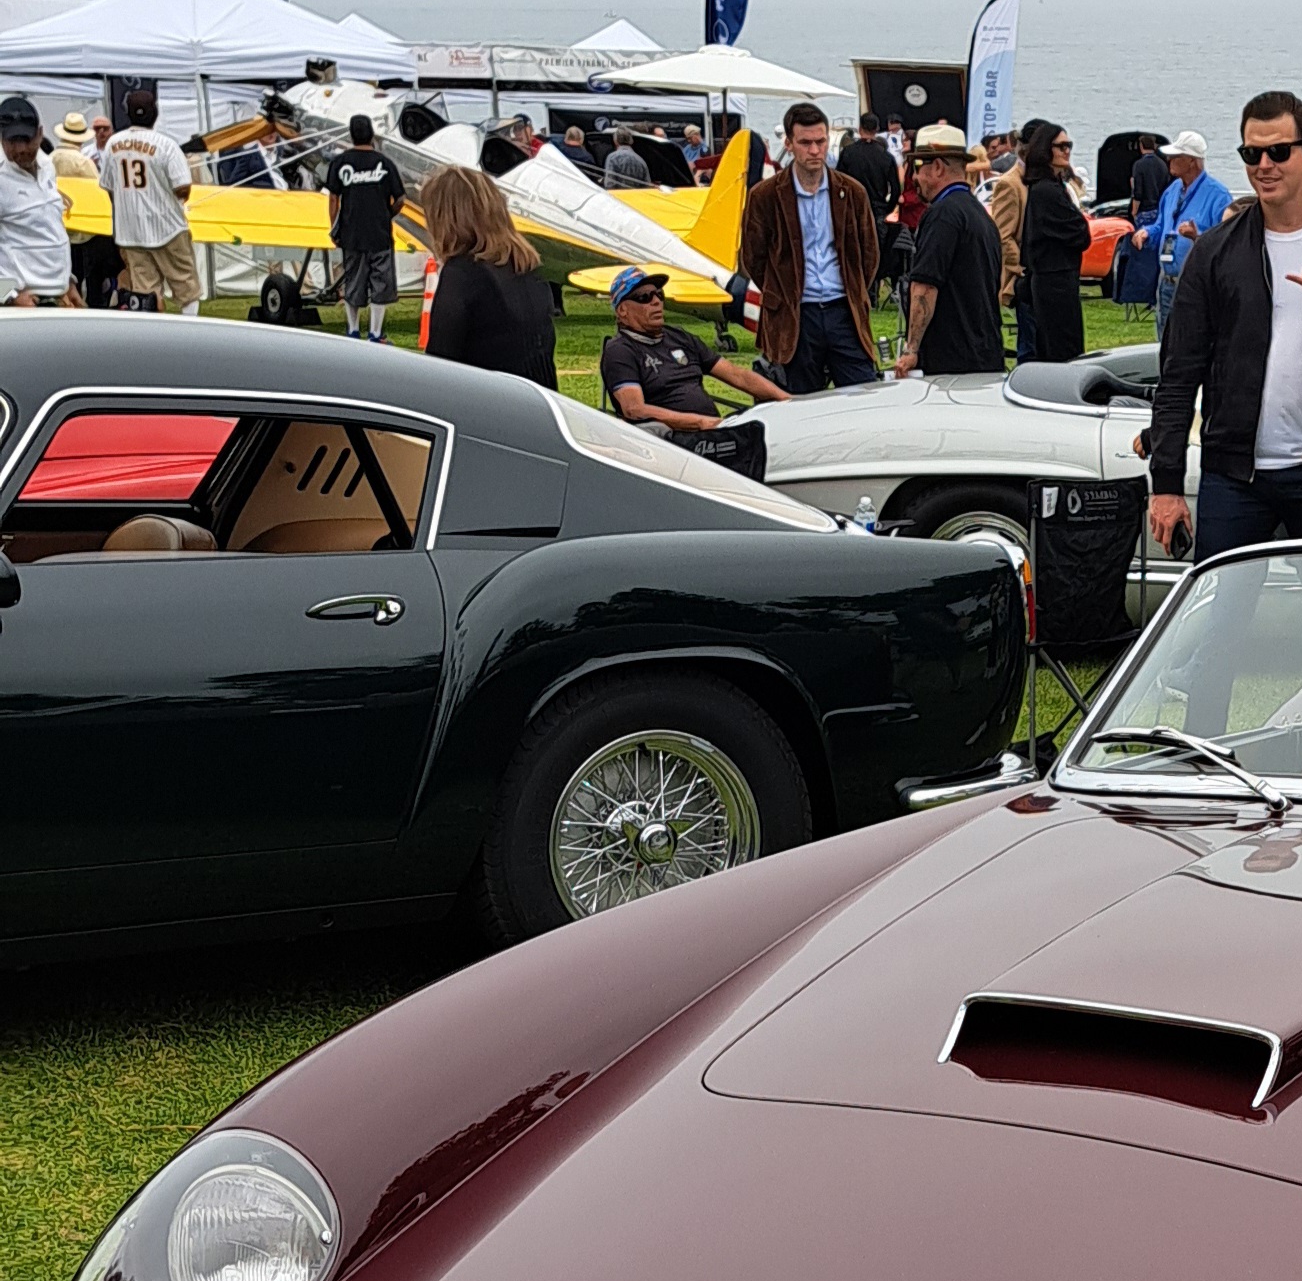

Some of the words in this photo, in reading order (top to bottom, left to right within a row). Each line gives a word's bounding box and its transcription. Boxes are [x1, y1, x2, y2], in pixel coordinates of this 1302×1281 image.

[984, 70, 999, 98] BAR
[121, 158, 147, 189] 13
[338, 161, 388, 187] Donut
